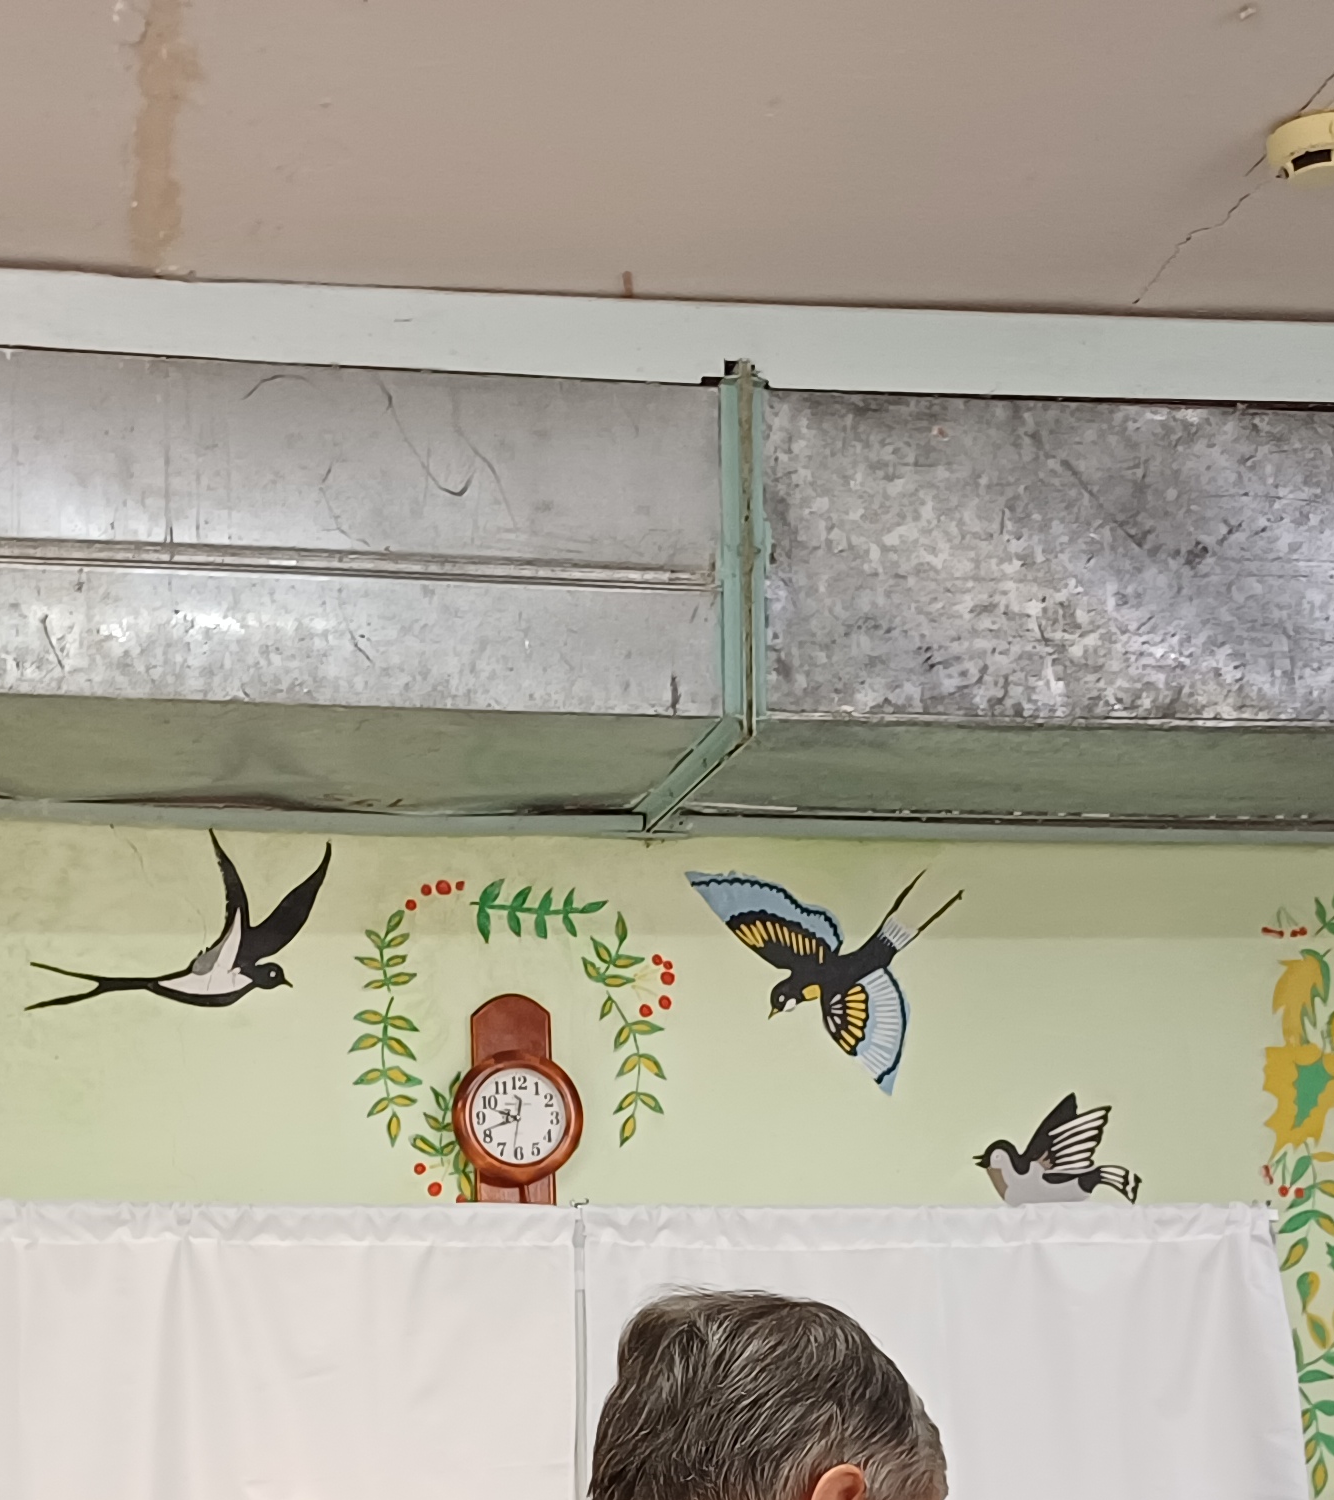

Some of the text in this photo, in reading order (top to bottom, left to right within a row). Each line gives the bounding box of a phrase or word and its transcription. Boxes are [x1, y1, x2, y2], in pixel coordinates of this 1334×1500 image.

[494, 1081, 508, 1095] 11
[511, 1075, 528, 1091] 12
[533, 1081, 540, 1096] 1
[482, 1095, 498, 1110] 10
[544, 1093, 554, 1108] 2
[476, 1110, 486, 1126] 9
[549, 1111, 560, 1126] 3
[482, 1128, 493, 1144] 8
[496, 1142, 507, 1157] 7
[513, 1146, 524, 1161] 6
[531, 1142, 541, 1157] 5
